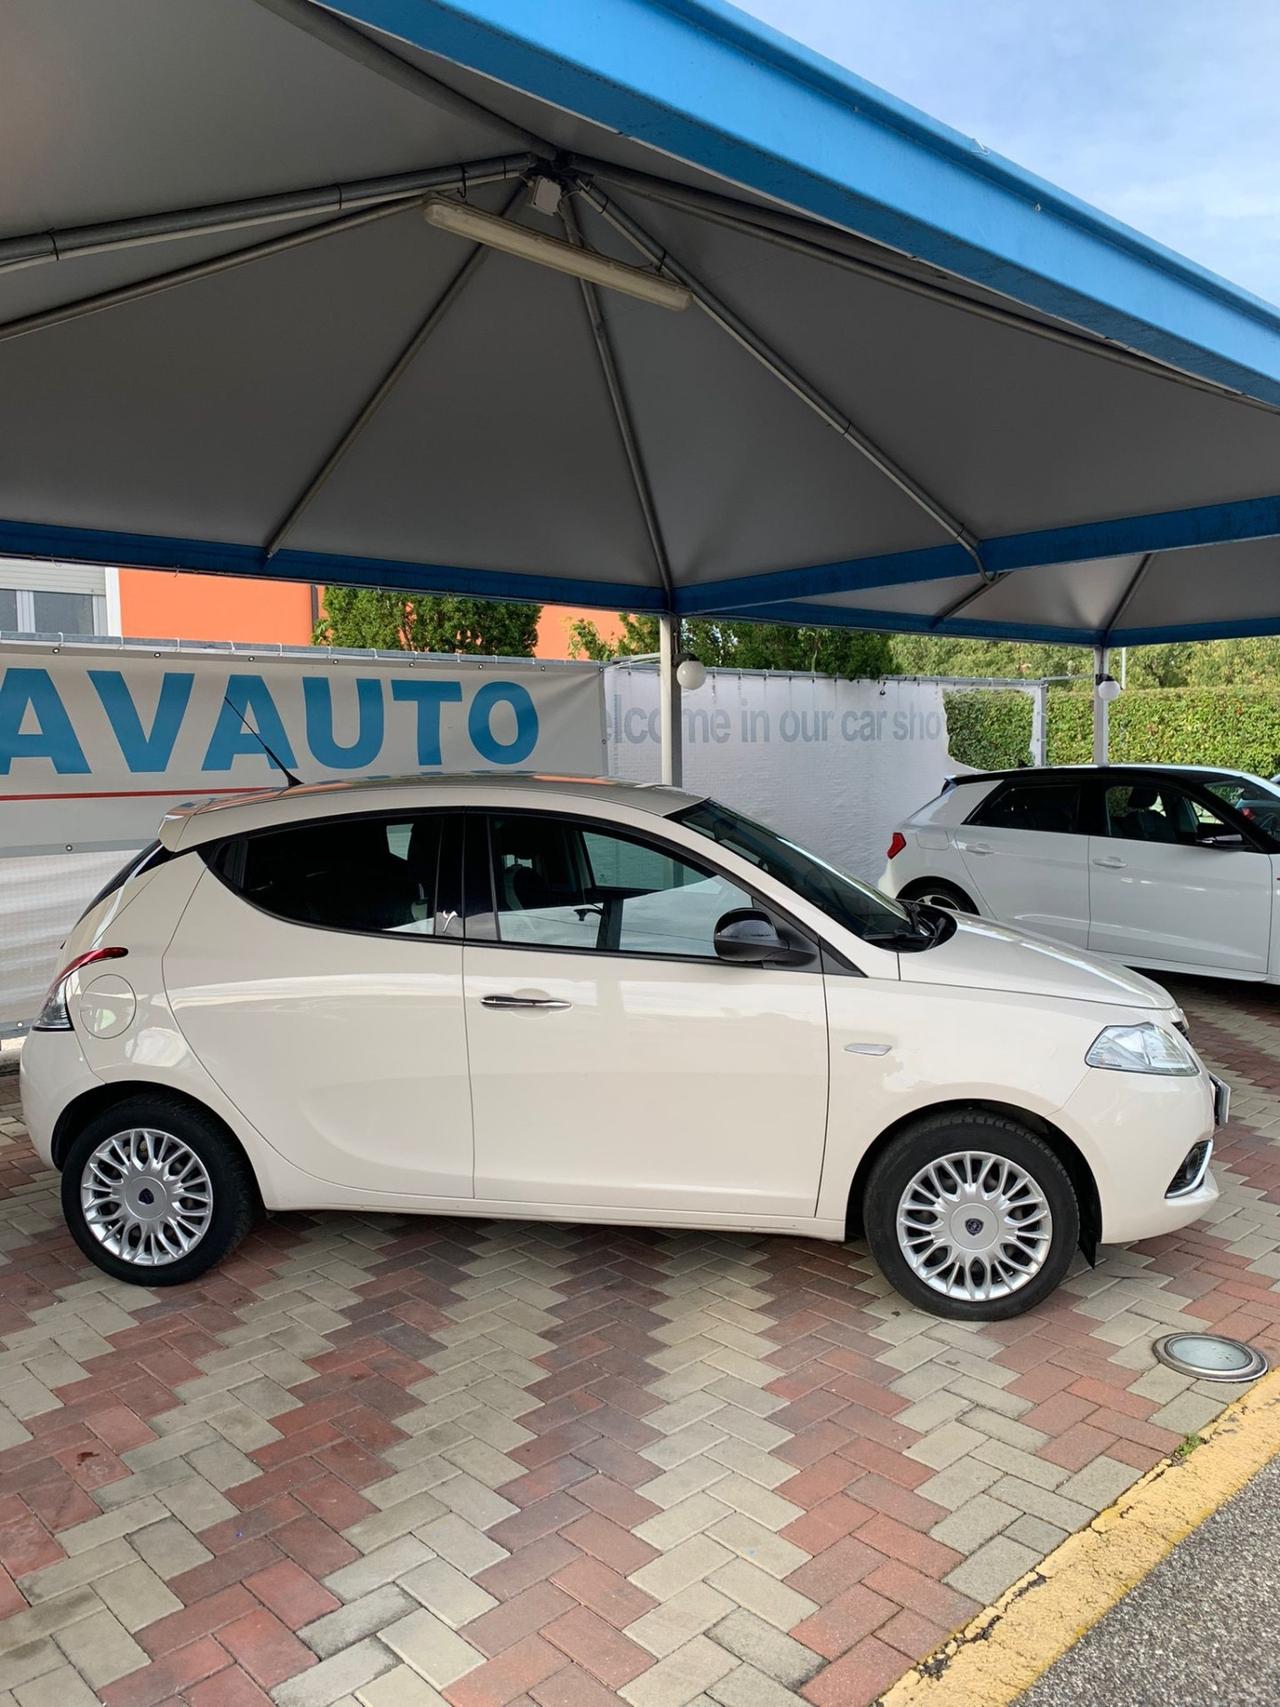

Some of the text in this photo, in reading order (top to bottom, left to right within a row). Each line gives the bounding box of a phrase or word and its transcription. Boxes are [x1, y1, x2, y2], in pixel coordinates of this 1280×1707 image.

[0, 668, 539, 775] AVAUTO
[607, 694, 942, 744] lcome in our car sho
